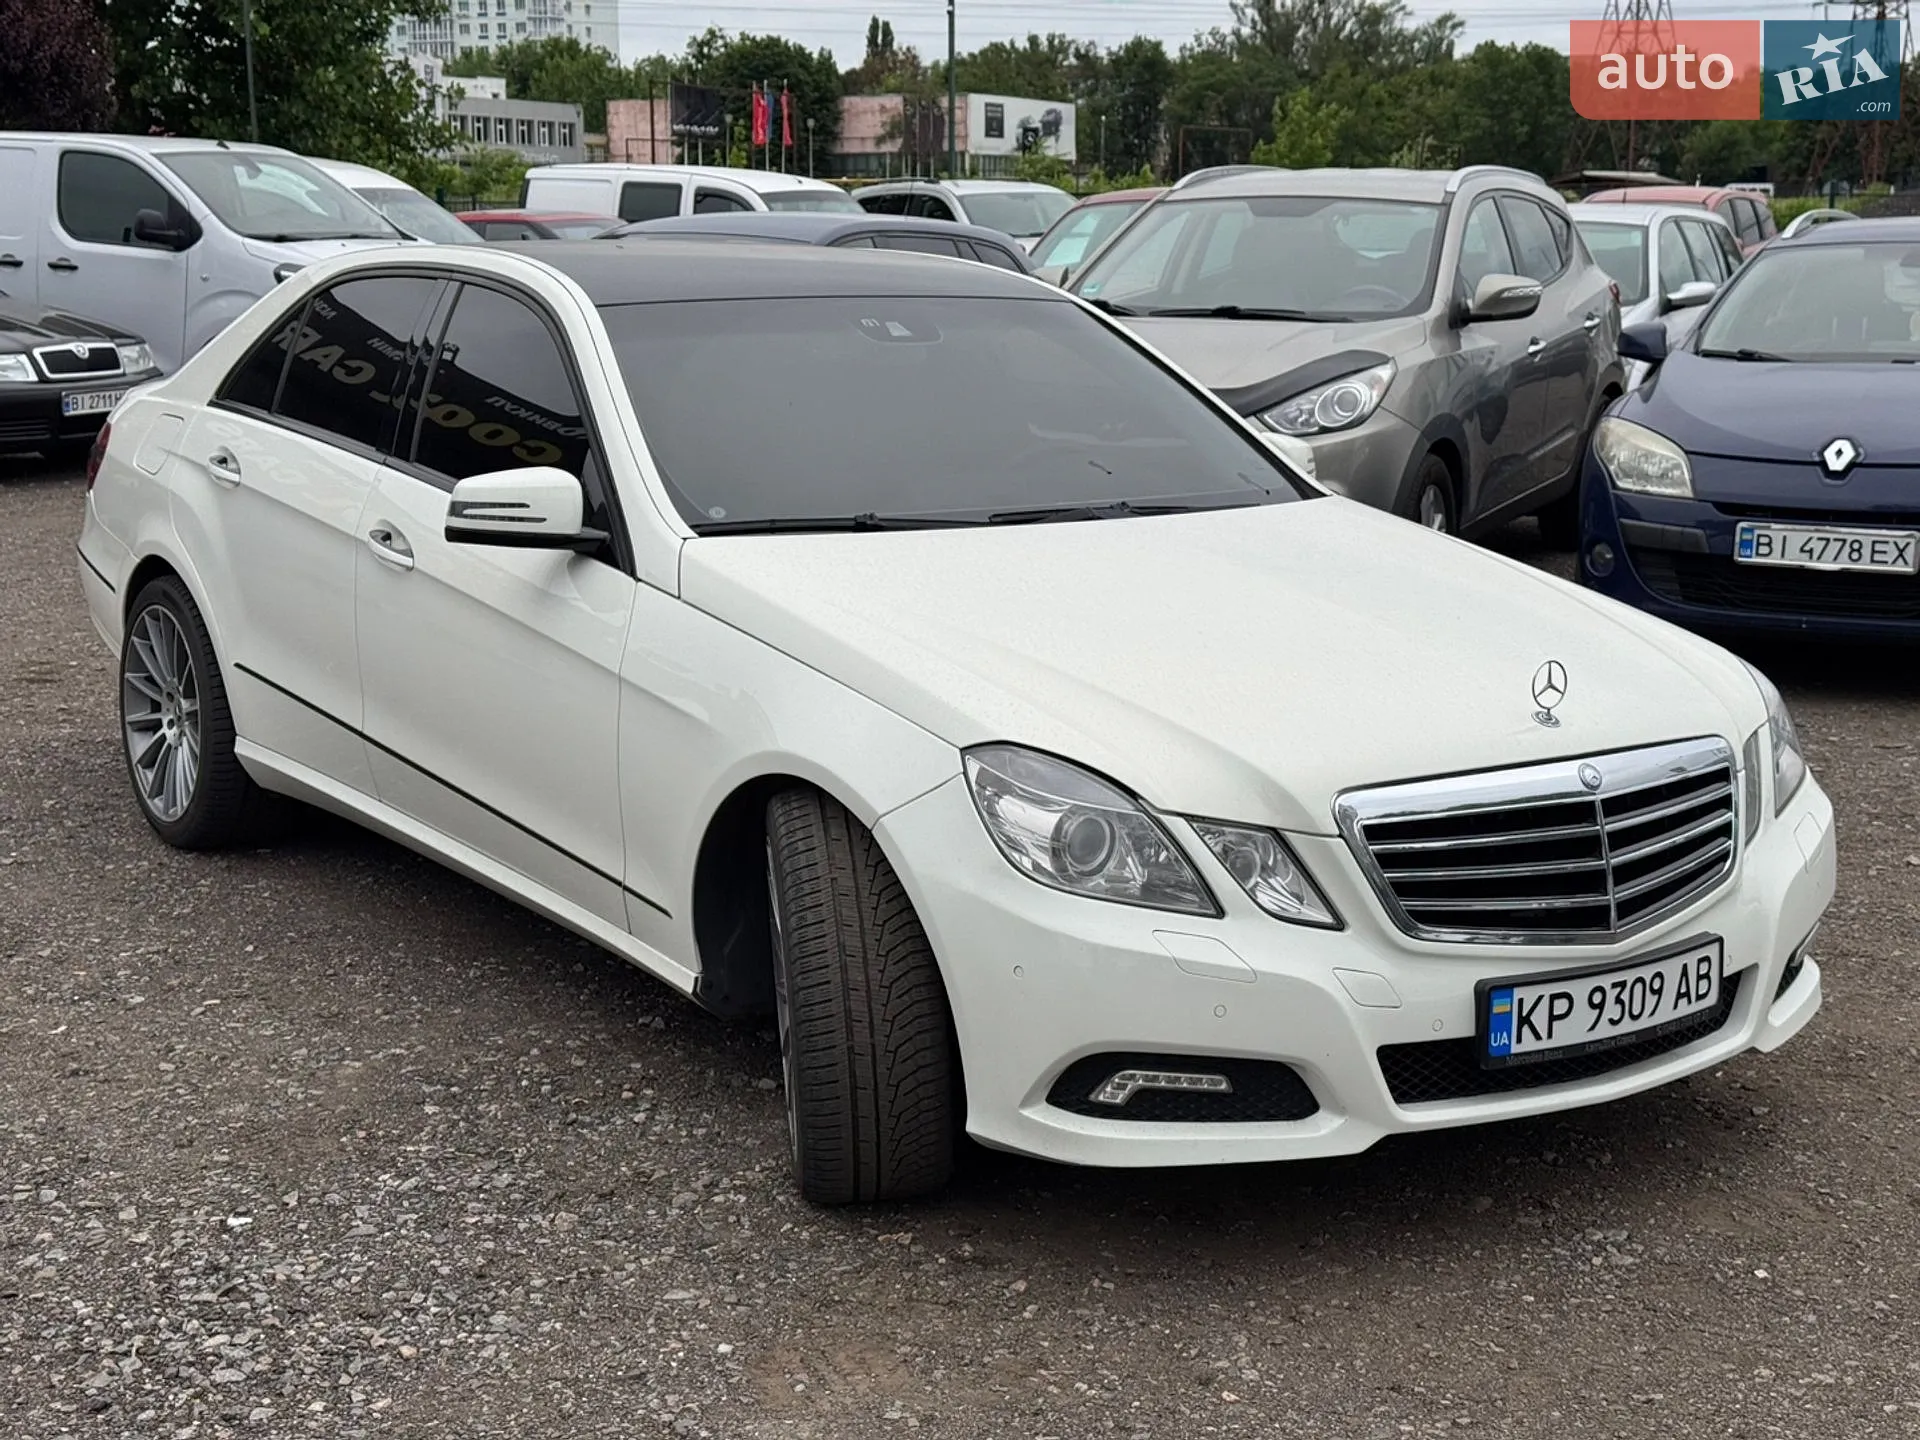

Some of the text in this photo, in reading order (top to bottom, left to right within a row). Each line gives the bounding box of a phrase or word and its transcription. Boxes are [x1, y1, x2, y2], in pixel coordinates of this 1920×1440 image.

[72, 396, 84, 411] BI
[89, 393, 112, 409] 2711
[1756, 534, 1911, 565] BI 4778 EX
[1515, 991, 1574, 1045] KP
[1586, 970, 1665, 1033] 9309
[1672, 954, 1712, 1011] AB
[1490, 1031, 1509, 1047] UA
